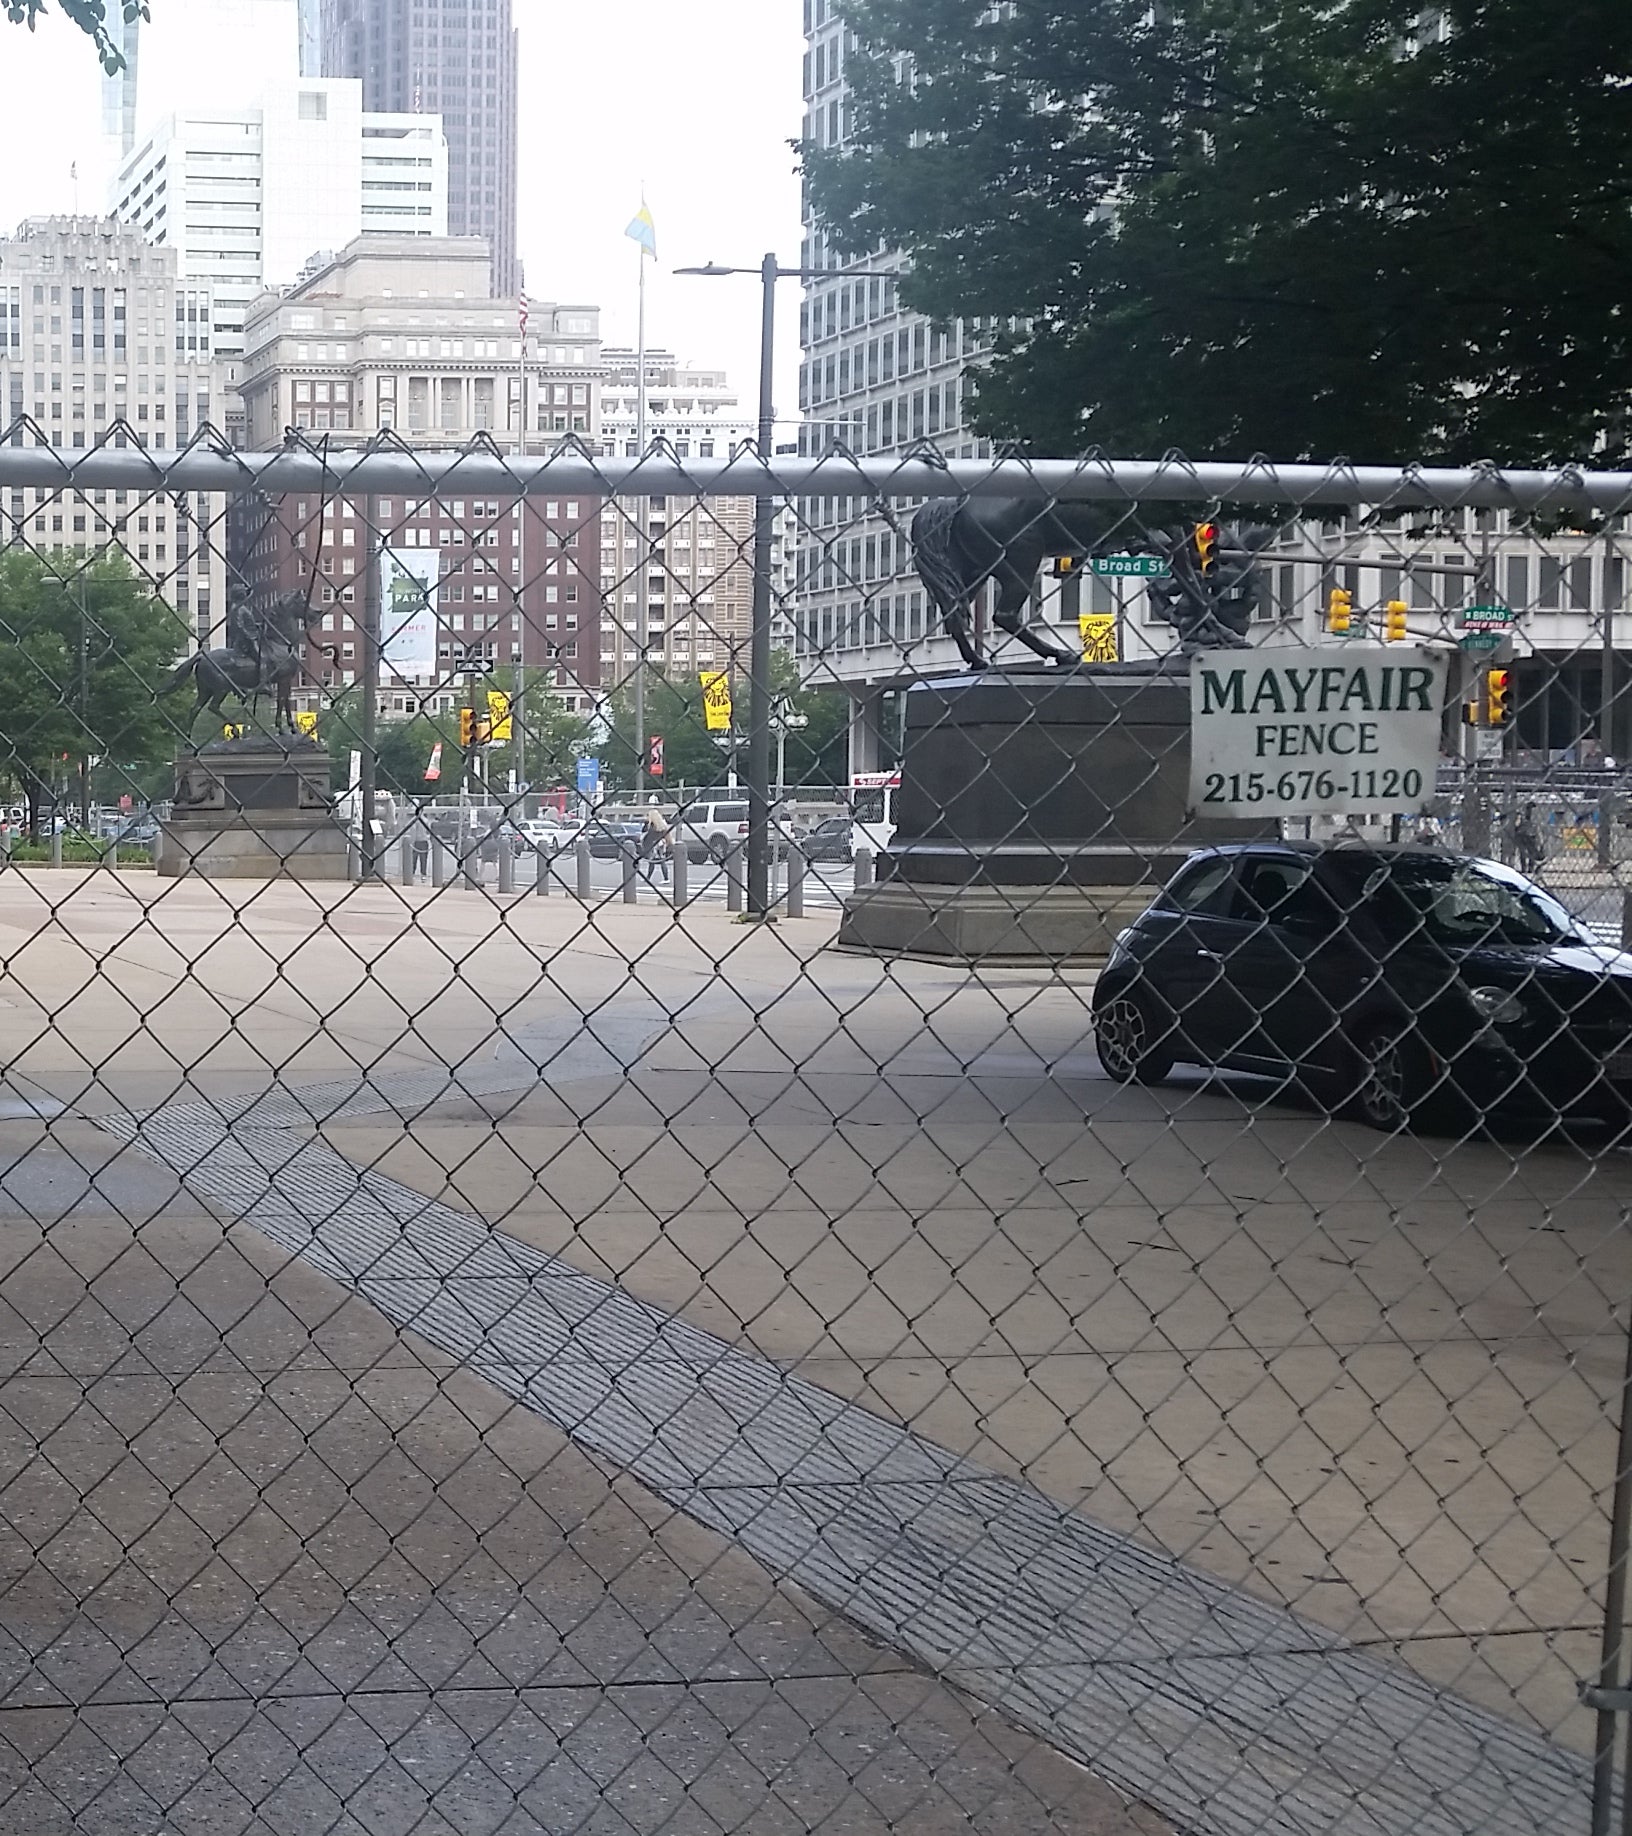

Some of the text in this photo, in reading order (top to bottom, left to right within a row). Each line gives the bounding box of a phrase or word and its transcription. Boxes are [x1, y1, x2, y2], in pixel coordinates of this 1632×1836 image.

[1098, 559, 1164, 572] Broad St
[1473, 611, 1505, 621] BROAD
[1200, 667, 1434, 714] MAYFAIR
[1256, 722, 1379, 757] FENCE
[1203, 768, 1423, 802] 215-676-1120
